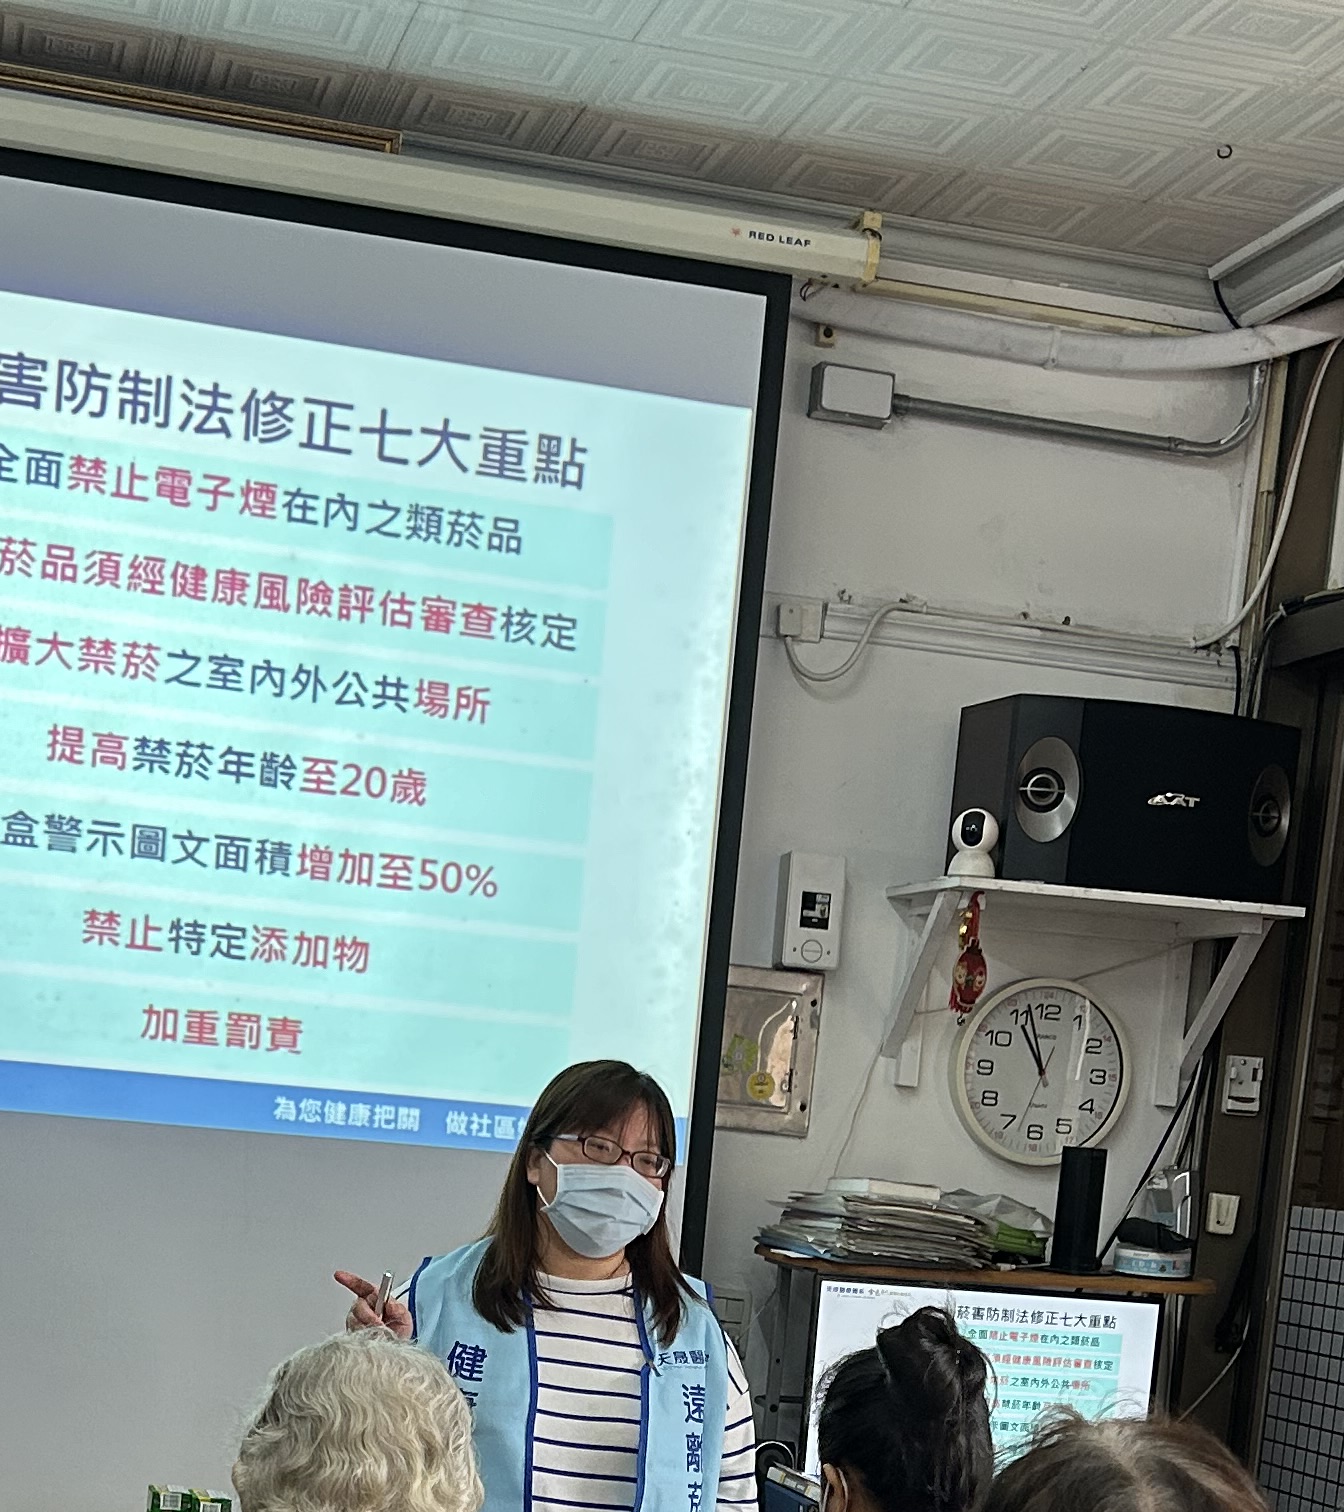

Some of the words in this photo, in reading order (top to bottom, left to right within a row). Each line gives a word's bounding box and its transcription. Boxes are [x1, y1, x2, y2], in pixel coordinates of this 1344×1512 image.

[749, 230, 775, 242] RED
[778, 235, 811, 247] LEAF
[46, 725, 428, 807] 提高禁菸年齡至20歲
[81, 908, 371, 974] 禁止特定添加物
[1009, 1008, 1030, 1026] 11
[1035, 1003, 1061, 1021] 12
[140, 1004, 305, 1056] 加重罰責
[1072, 1014, 1083, 1031] 1
[985, 1030, 1012, 1047] 10
[1085, 1038, 1103, 1054] 2
[976, 1059, 994, 1076] 9
[1089, 1068, 1107, 1085] 3
[981, 1090, 998, 1107] 8
[1078, 1098, 1095, 1114] 4
[273, 1096, 420, 1132] 為您健康把關
[445, 1110, 528, 1141] 做社區
[999, 1113, 1017, 1130] 7
[1055, 1118, 1073, 1135] 5
[1026, 1124, 1044, 1141] 6
[956, 1305, 1118, 1329] 菸害防制法修正七大重點
[657, 1349, 709, 1367] 天晟醫
